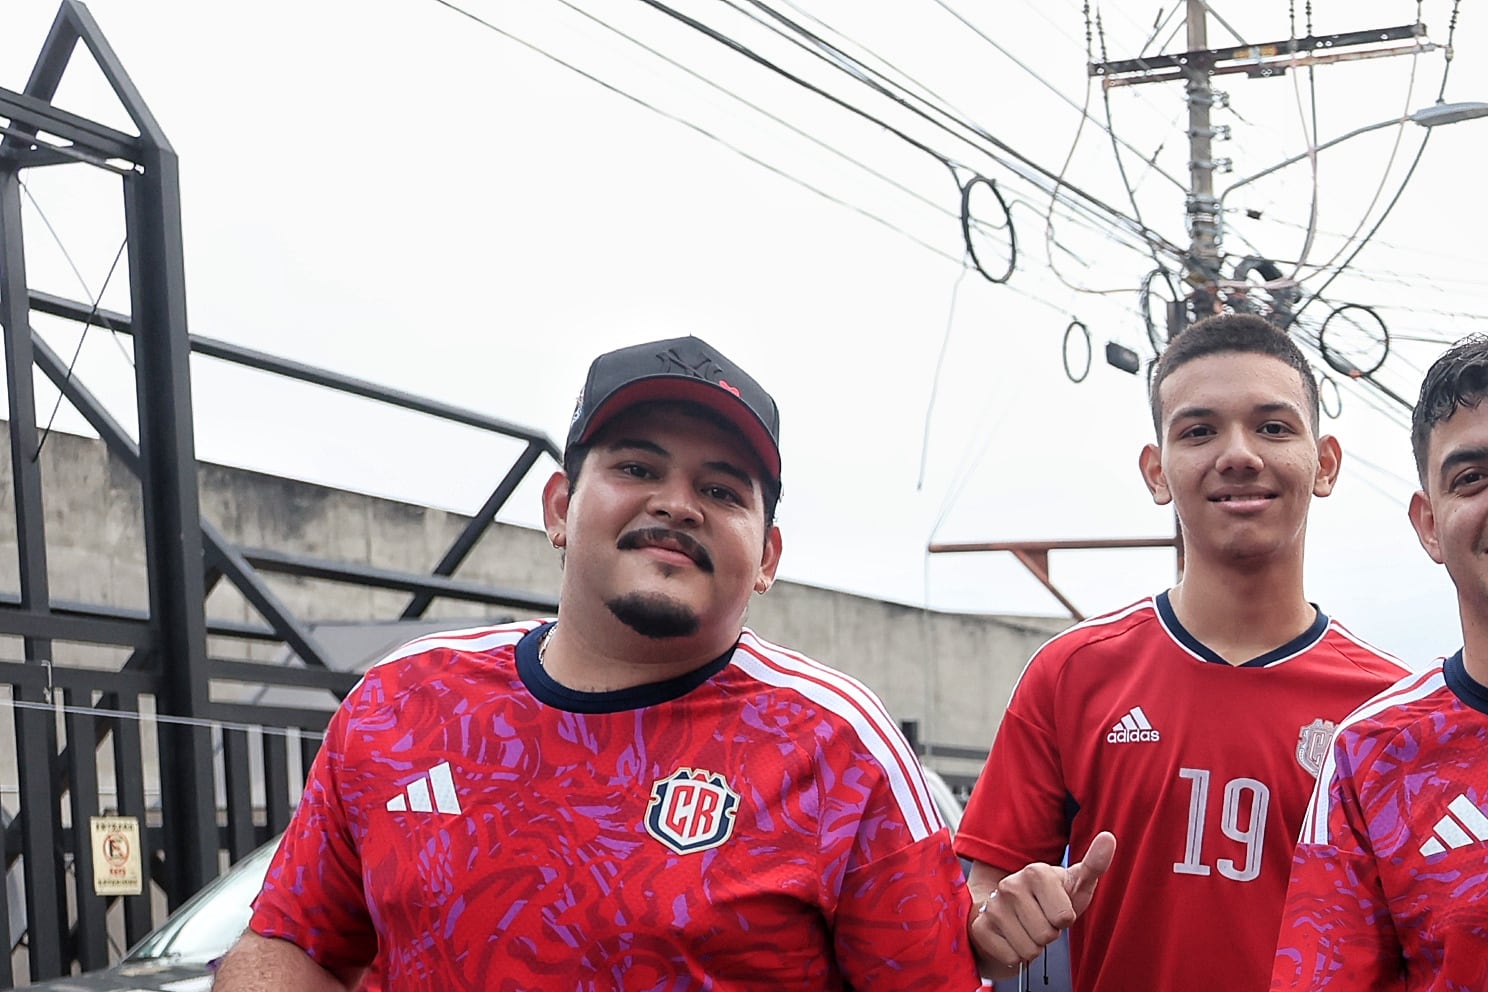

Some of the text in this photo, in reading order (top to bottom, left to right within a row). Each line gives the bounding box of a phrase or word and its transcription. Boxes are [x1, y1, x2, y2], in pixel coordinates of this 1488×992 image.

[1107, 728, 1160, 744] adidas
[665, 785, 720, 839] CR
[1173, 767, 1270, 882] 19
